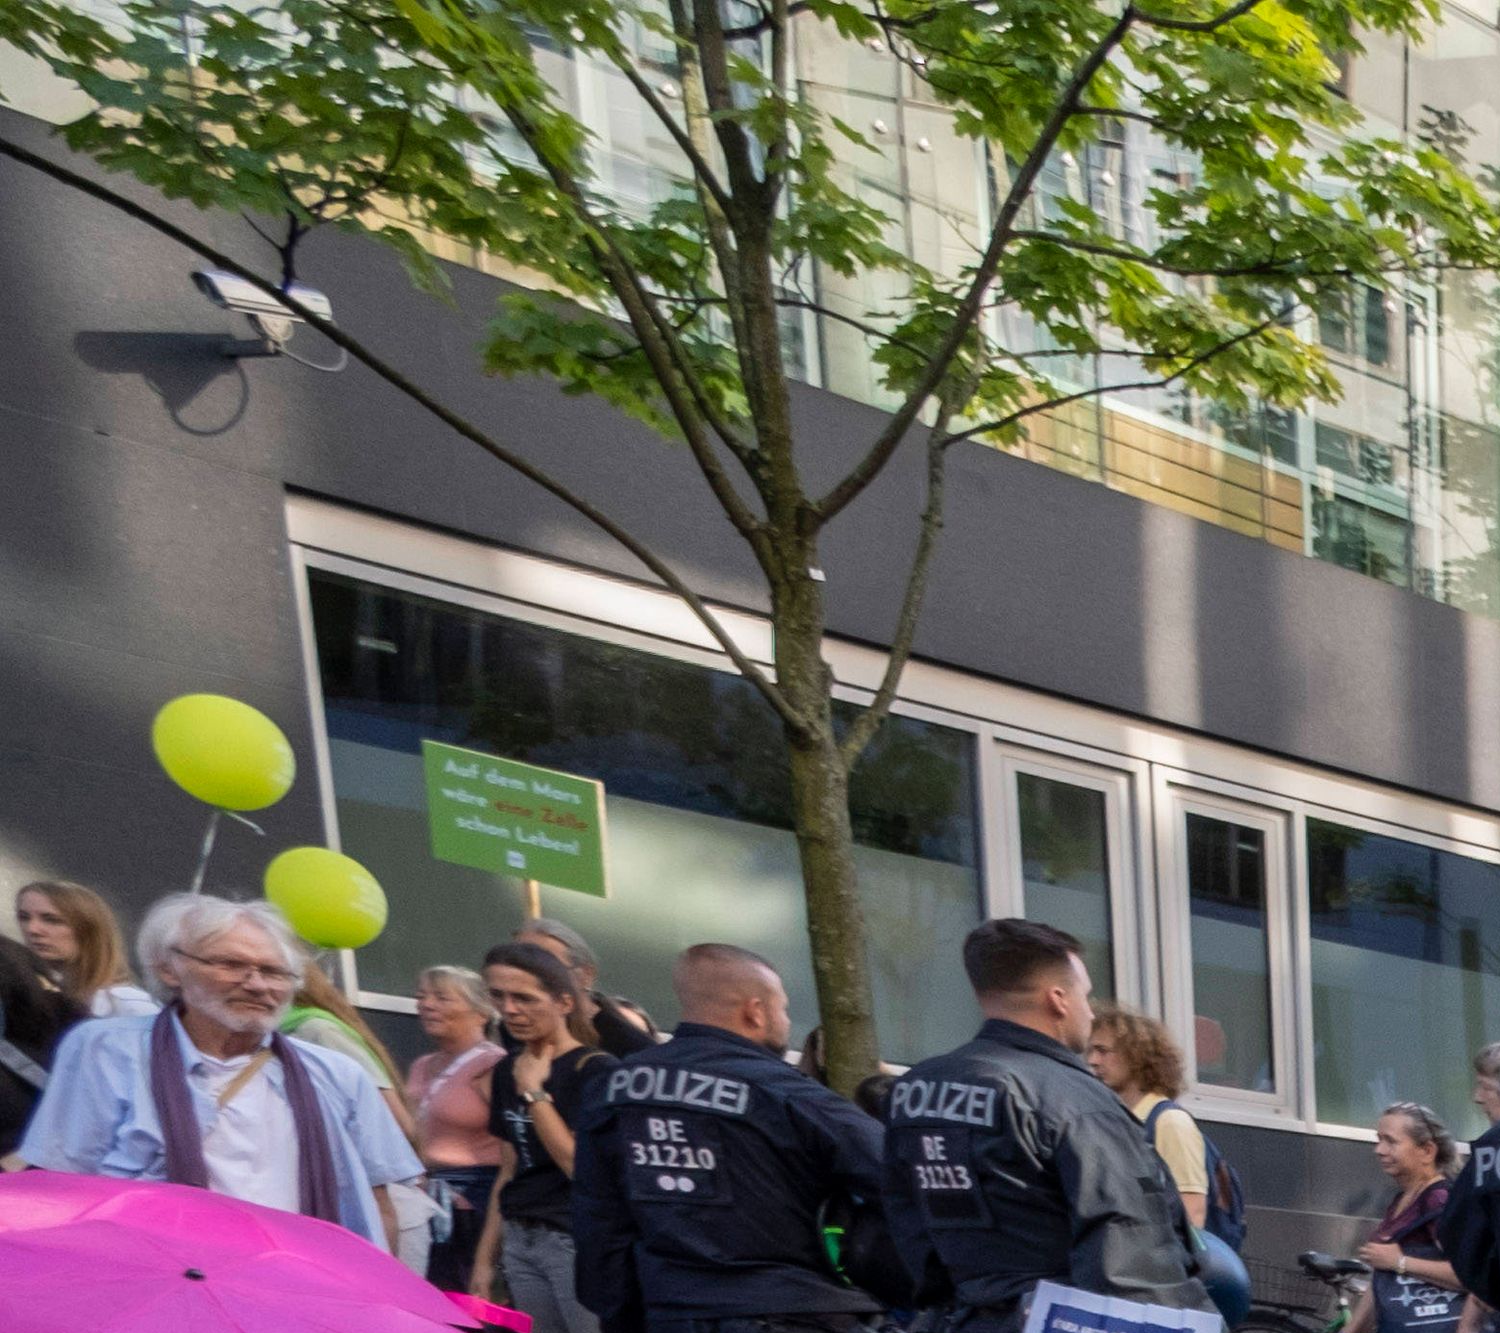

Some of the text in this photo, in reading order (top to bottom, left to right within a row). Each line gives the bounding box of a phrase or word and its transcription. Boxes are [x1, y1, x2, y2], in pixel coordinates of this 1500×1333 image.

[607, 1066, 750, 1115] POLIZEI
[890, 1080, 998, 1128] POLIZEI
[648, 1116, 688, 1143] BE
[631, 1142, 716, 1171] 31210
[922, 1135, 948, 1161] BE
